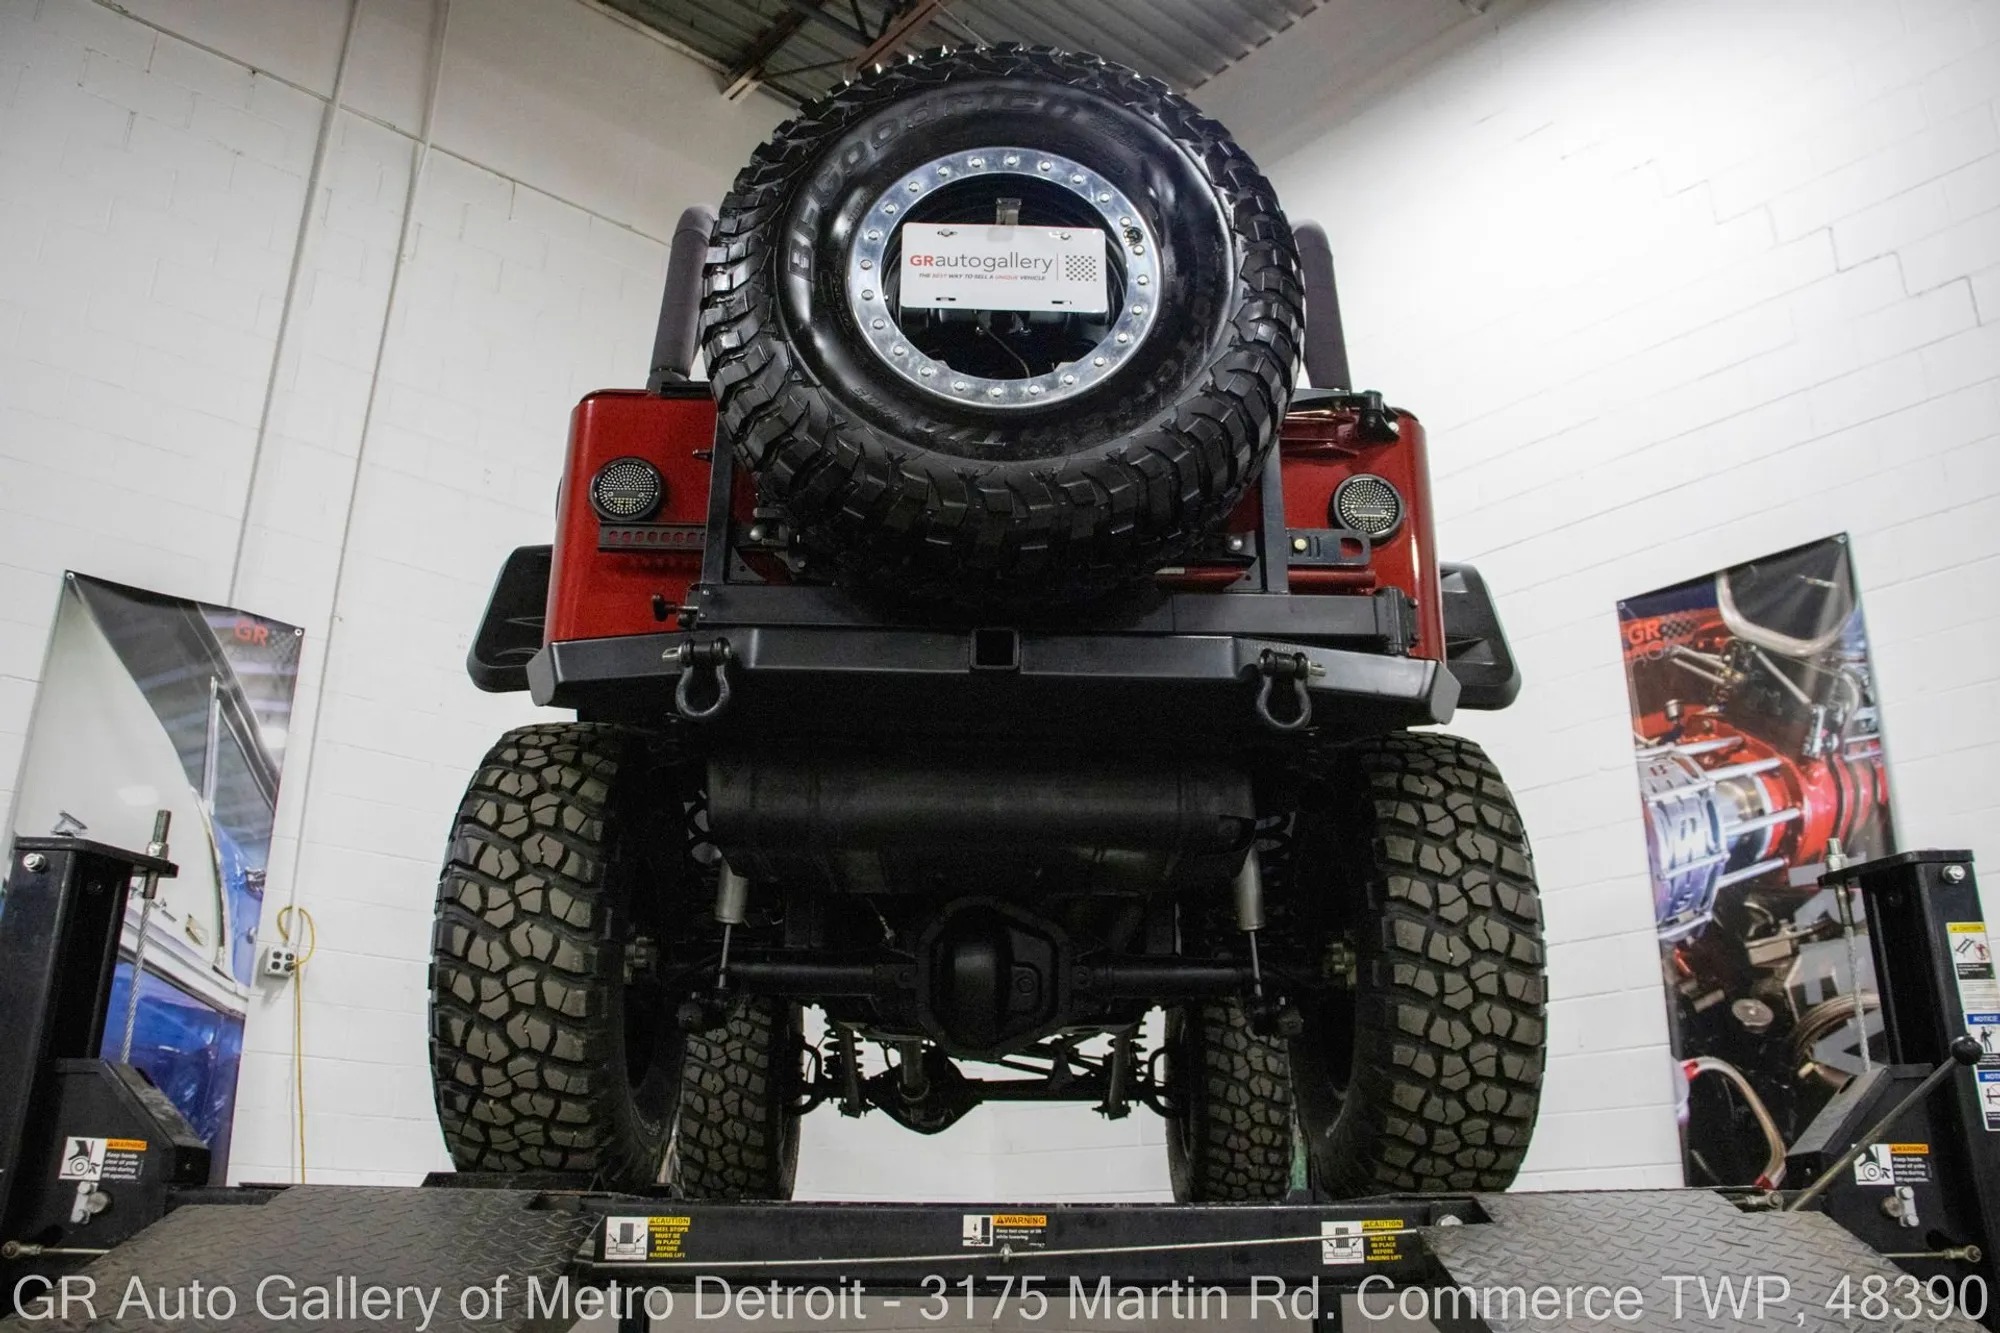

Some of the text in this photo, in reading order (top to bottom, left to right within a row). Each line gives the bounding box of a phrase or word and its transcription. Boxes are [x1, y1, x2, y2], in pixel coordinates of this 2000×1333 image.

[909, 251, 1053, 274] GRautogallery
[234, 617, 269, 647] GR
[1628, 618, 1661, 645] GR
[656, 1217, 689, 1225] CAUTION
[1369, 1220, 1402, 1228] CAUTION
